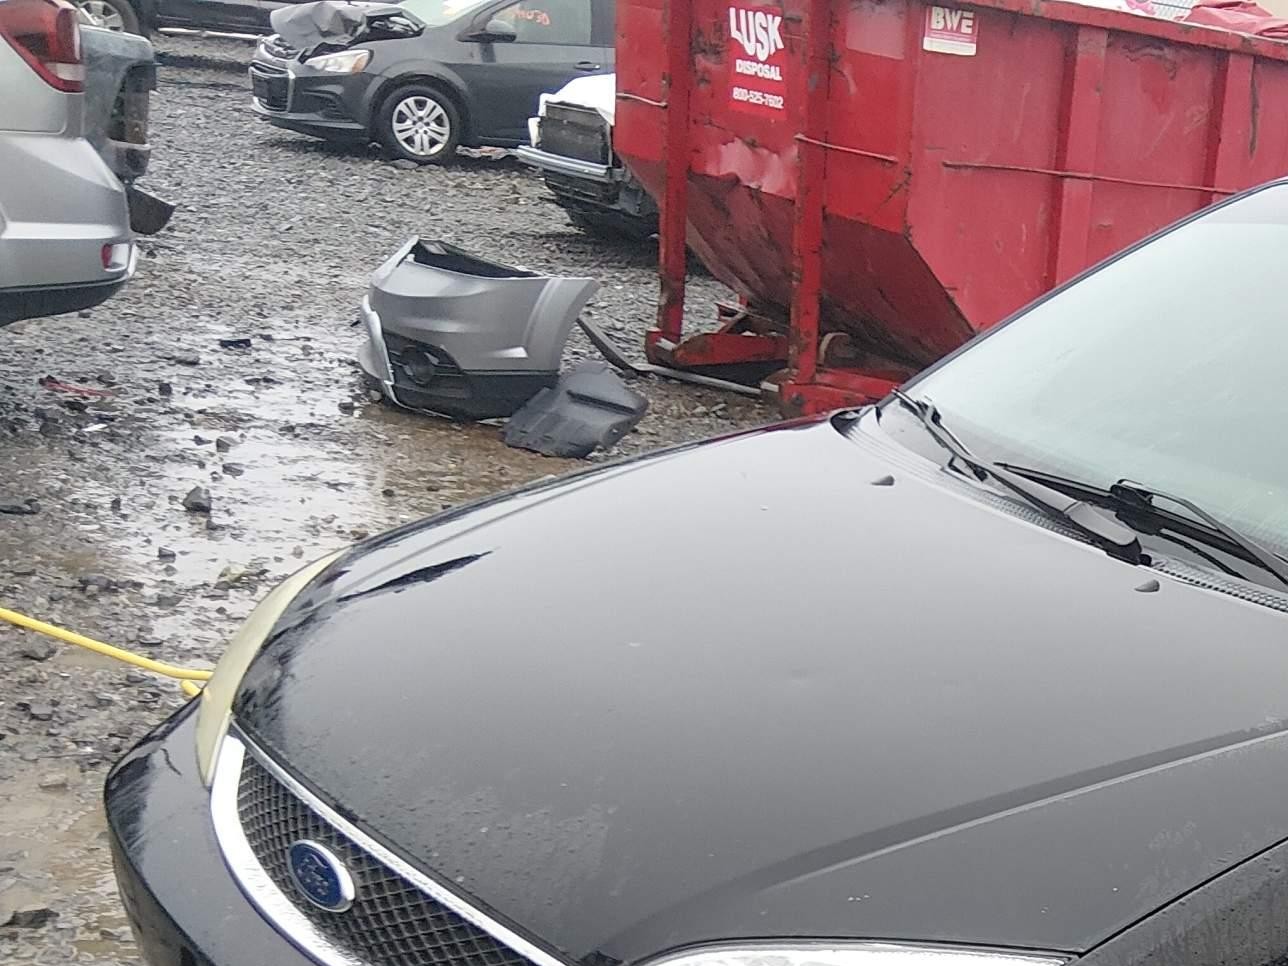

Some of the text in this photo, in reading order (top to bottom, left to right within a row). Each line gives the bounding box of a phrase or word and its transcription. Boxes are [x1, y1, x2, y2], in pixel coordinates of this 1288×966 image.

[729, 7, 784, 61] LUSK
[931, 6, 974, 34] BWE
[735, 59, 783, 81] DISPOSAL
